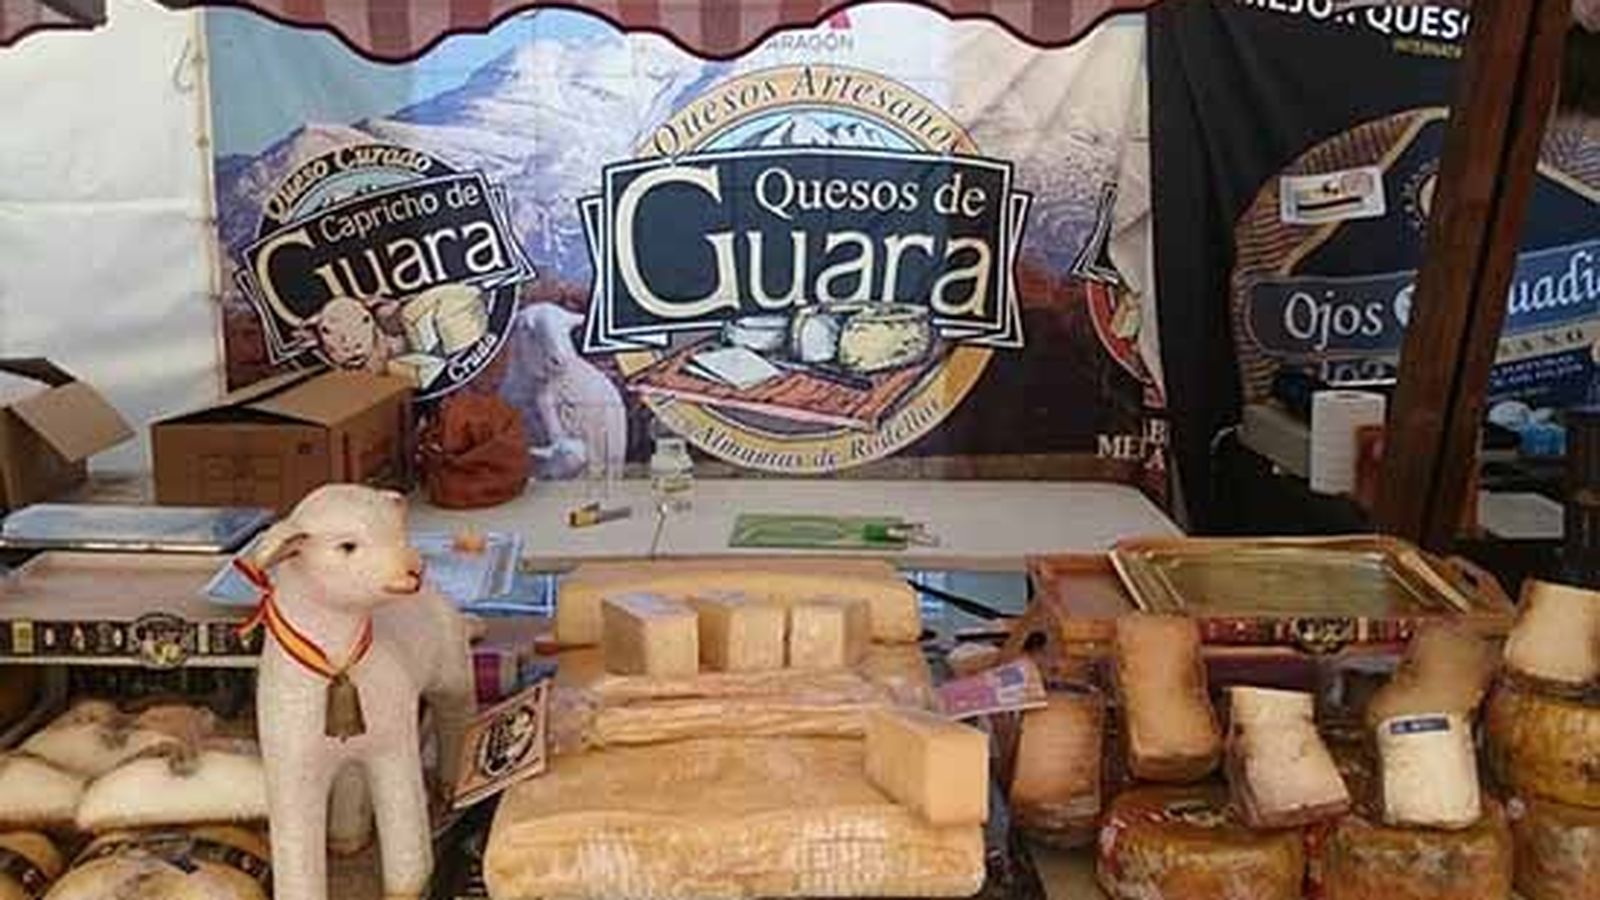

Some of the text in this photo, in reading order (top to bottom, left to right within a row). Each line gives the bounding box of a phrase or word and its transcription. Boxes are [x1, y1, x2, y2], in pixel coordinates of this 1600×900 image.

[653, 79, 778, 162] Quesos
[265, 145, 432, 223] Queso Curado
[320, 180, 480, 242] Capricho de
[755, 167, 987, 219] Quesos de
[256, 219, 506, 327] Guara
[616, 164, 993, 320] Guara
[1508, 250, 1600, 315] uadi
[1284, 290, 1384, 350] Ojos
